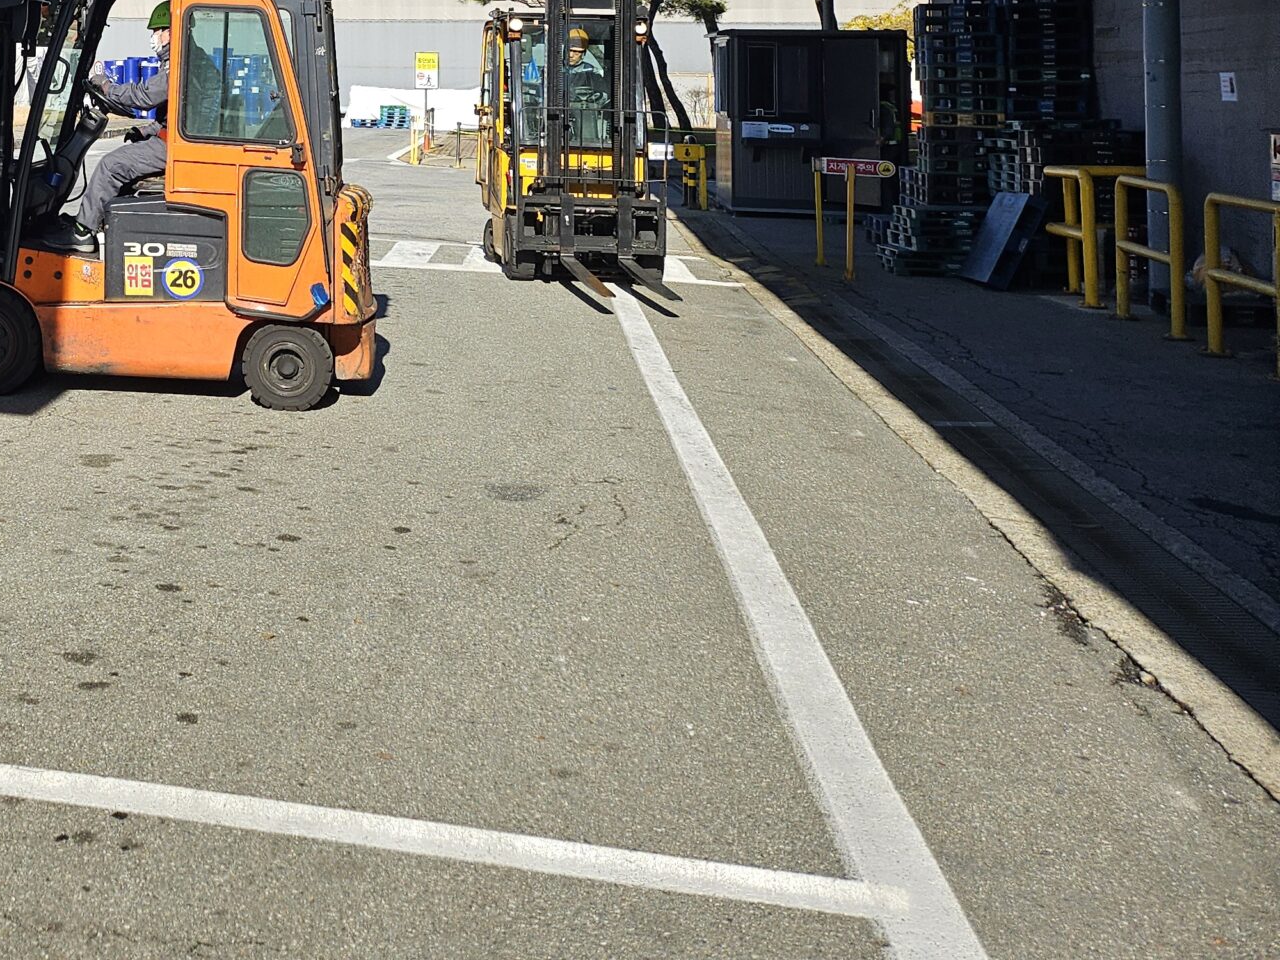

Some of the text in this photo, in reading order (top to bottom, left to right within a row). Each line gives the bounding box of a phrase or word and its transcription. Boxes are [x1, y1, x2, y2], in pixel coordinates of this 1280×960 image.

[857, 163, 874, 172] 주의
[124, 242, 165, 257] 30
[127, 263, 151, 289] 위험
[170, 269, 196, 289] 26
